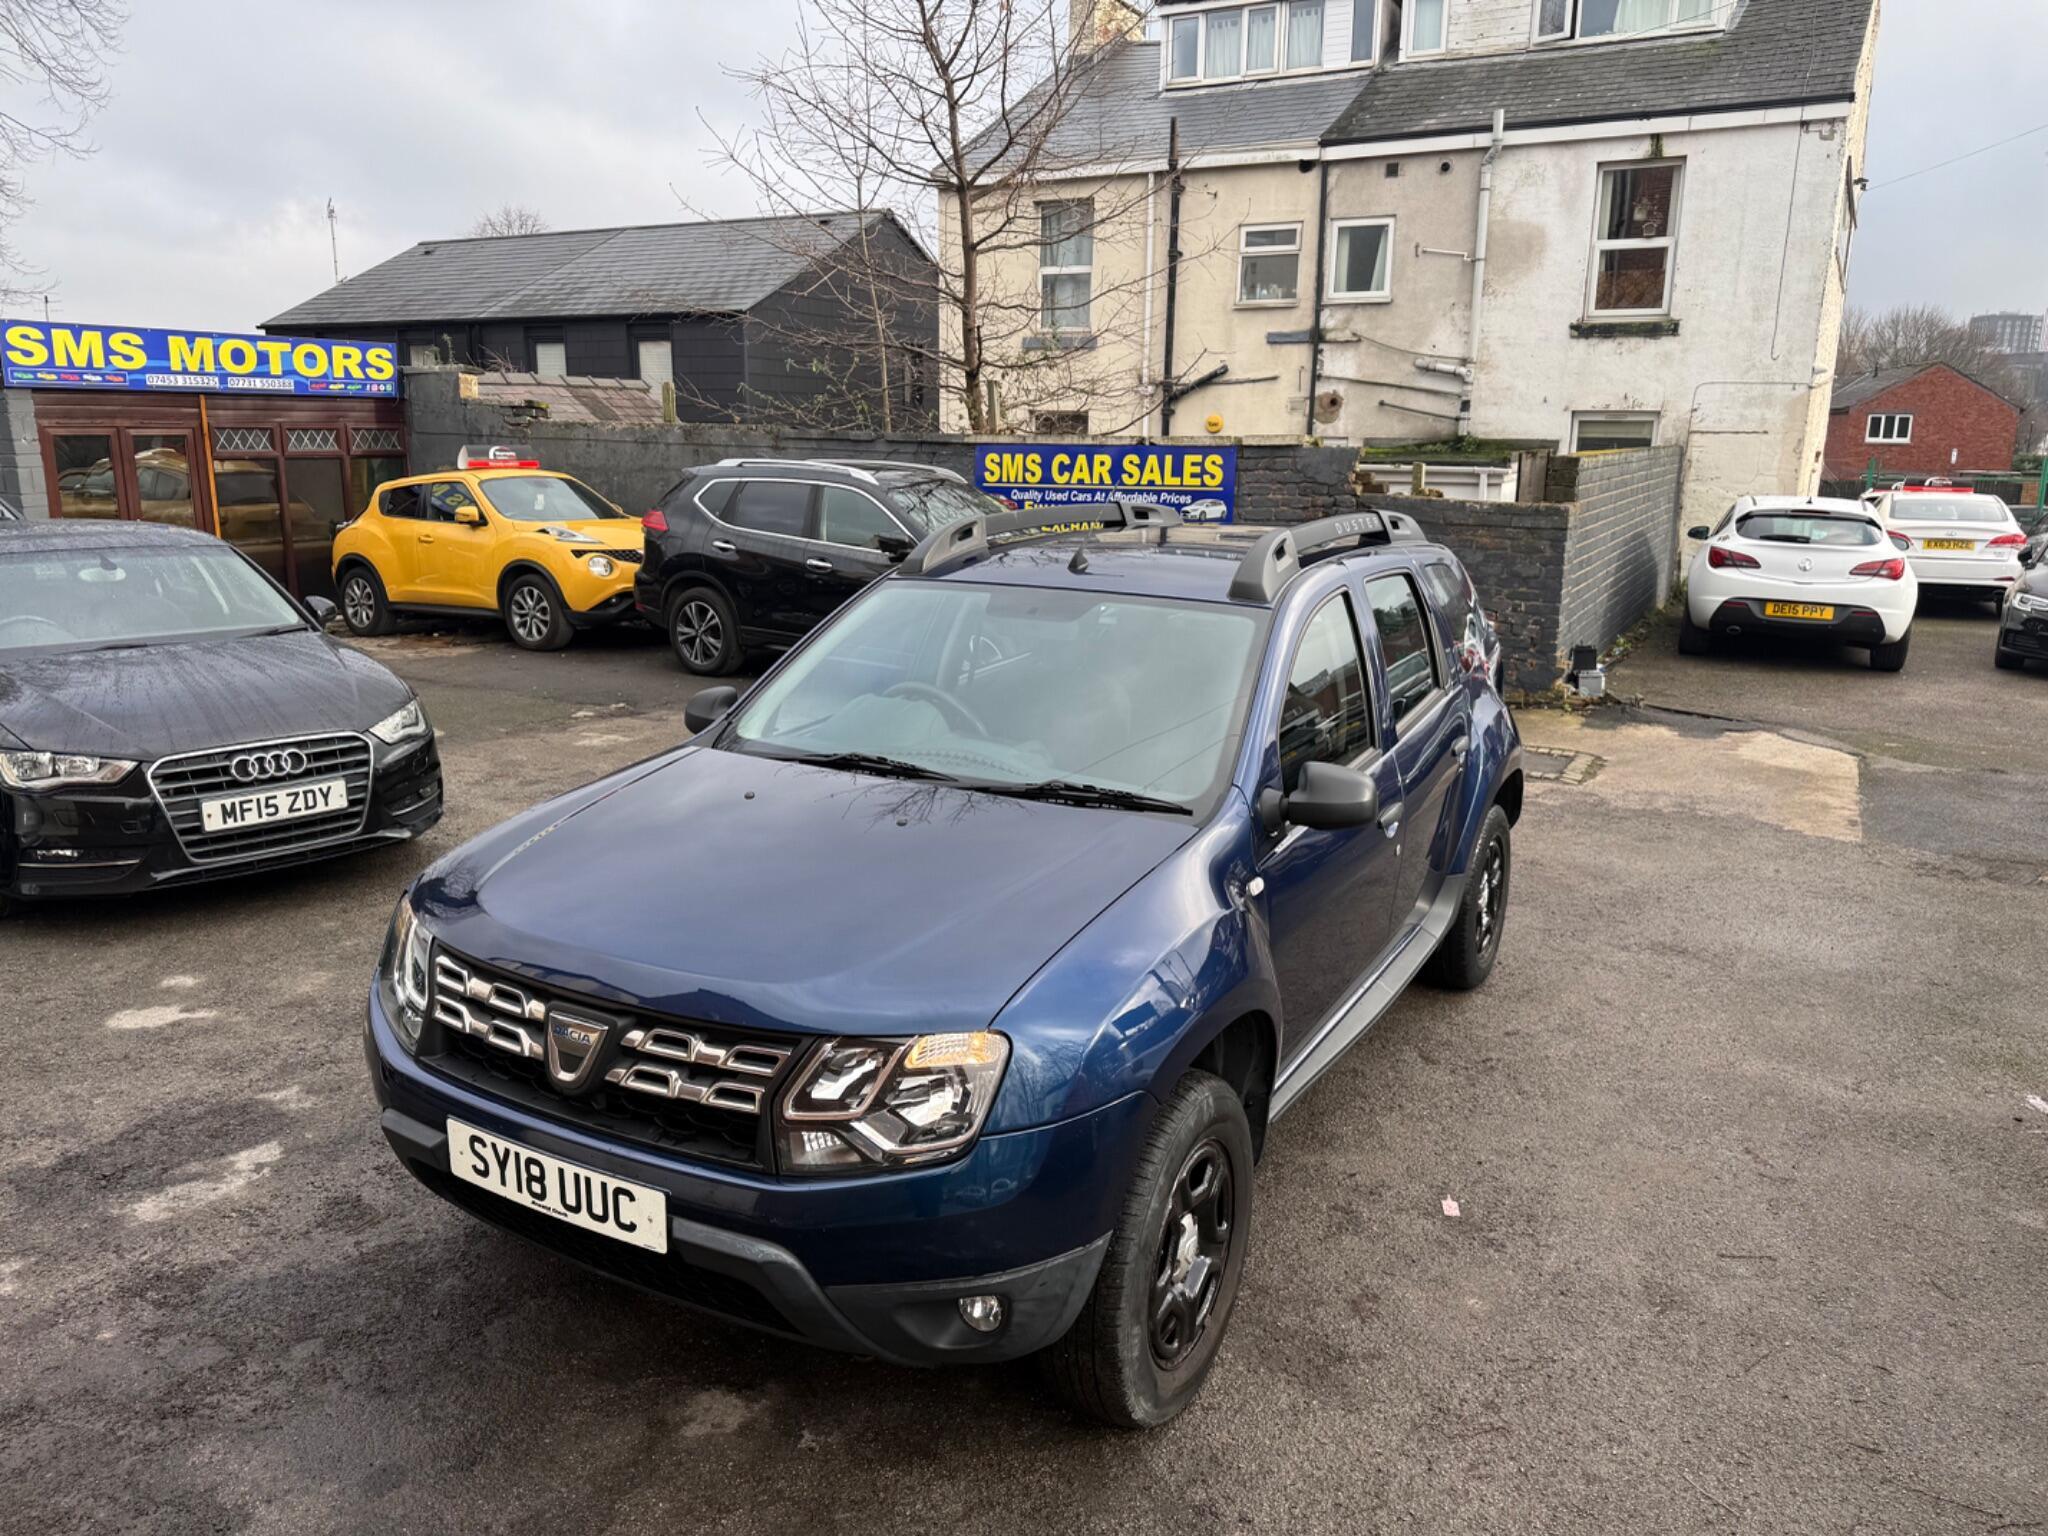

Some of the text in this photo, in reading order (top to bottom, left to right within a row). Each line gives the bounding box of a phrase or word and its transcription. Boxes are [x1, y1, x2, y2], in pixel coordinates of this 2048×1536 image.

[5, 326, 395, 380] SMS MOTORS
[984, 452, 1224, 487] SMS CAR SALES
[1011, 489, 1192, 504] Quality Used Cars At Affordable Prices
[1334, 517, 1378, 534] DUSTER
[1802, 604, 1826, 617] PPY
[220, 785, 332, 824] MF15 ZDY
[468, 1134, 638, 1233] SY18 UUC
